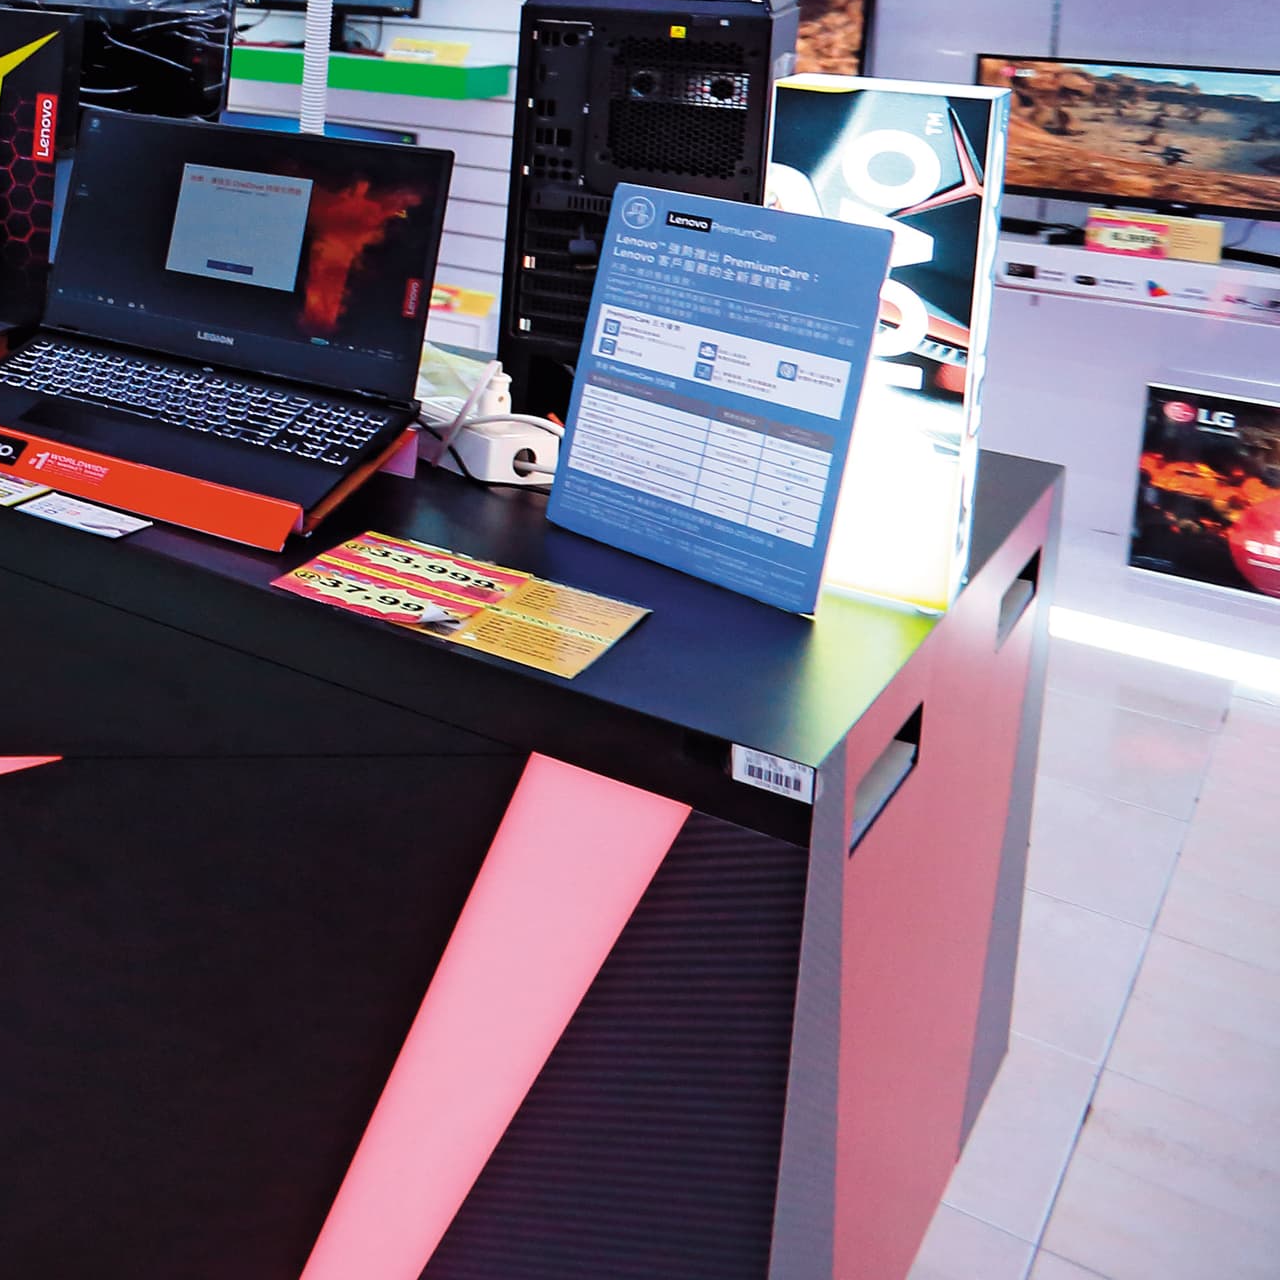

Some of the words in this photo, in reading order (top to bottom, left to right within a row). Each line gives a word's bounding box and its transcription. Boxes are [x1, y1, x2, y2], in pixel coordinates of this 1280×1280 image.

[37, 98, 53, 158] Lenovo
[668, 213, 709, 230] Lenovo
[710, 221, 777, 243] PremiumCare
[613, 246, 655, 264] Lenovo
[406, 281, 422, 316] Lenovo
[196, 330, 235, 346] LEGION
[1196, 407, 1237, 429] LG
[369, 547, 498, 590] 33,999
[317, 577, 427, 614] 37,99
